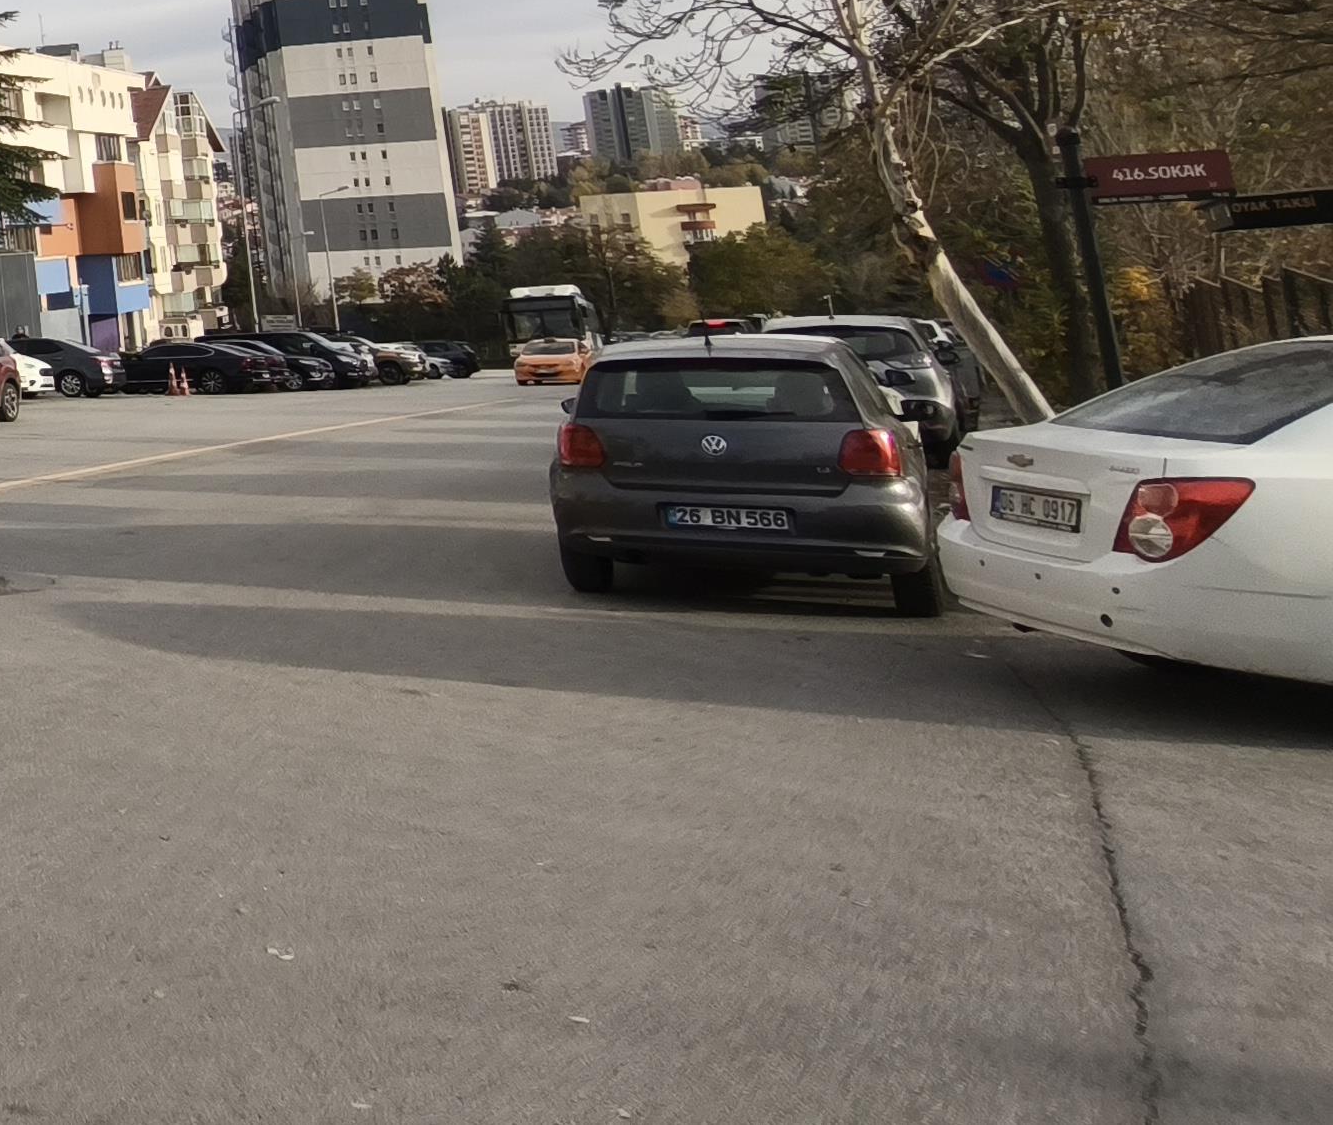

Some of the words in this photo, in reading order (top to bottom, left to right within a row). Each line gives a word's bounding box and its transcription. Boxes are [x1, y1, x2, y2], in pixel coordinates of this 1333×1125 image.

[1231, 200, 1270, 213] OYAK
[676, 507, 702, 524] 26
[710, 508, 742, 526] BN
[745, 511, 786, 528] 566
[1042, 498, 1076, 524] 0917
